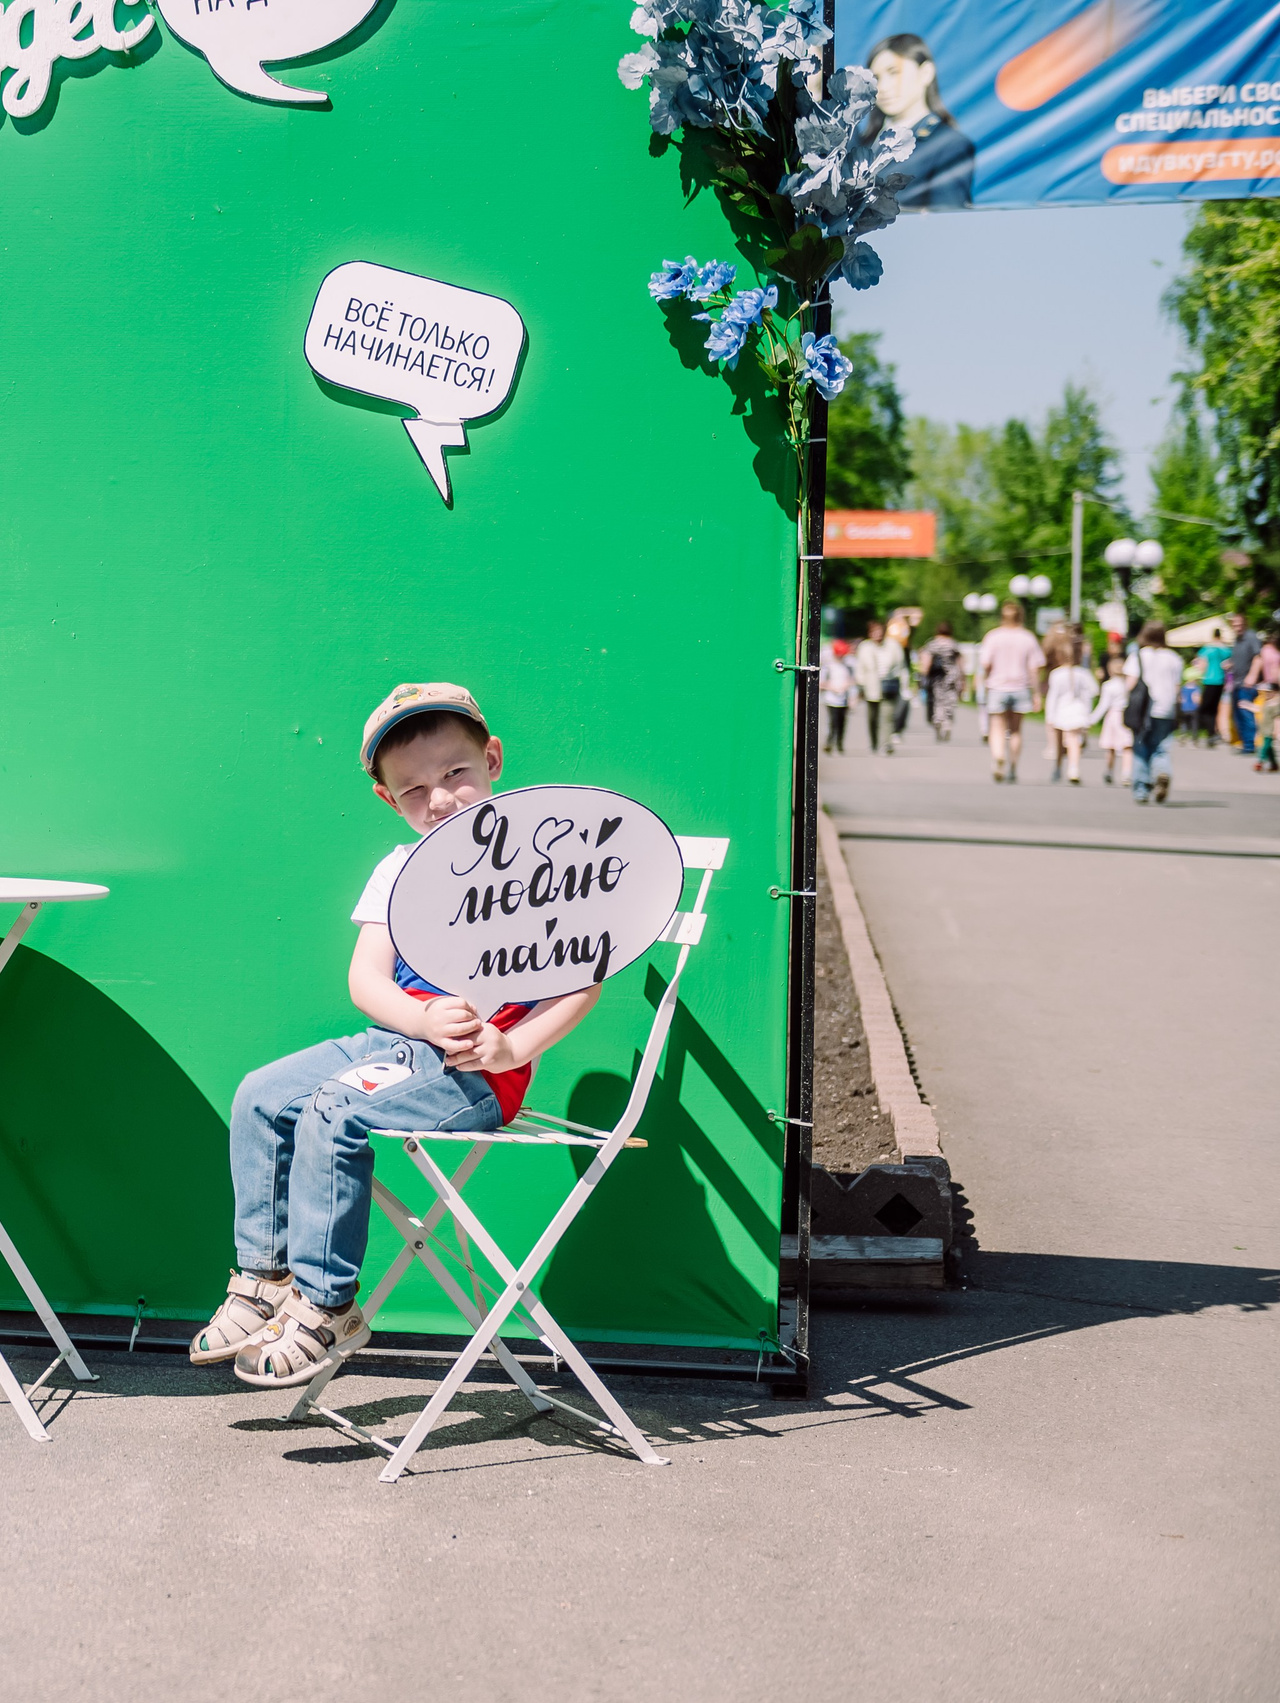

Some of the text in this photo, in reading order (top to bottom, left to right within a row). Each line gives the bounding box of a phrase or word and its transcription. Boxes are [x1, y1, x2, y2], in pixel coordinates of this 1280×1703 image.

[1142, 84, 1237, 109] ВЫБЕРИ
[323, 323, 496, 394] НАЧИНАЕТСЯ!
[344, 297, 491, 360] ВСЁ ТОЛЬКО
[449, 817, 630, 926] люблю
[451, 803, 520, 876] Я
[469, 930, 618, 983] папу
